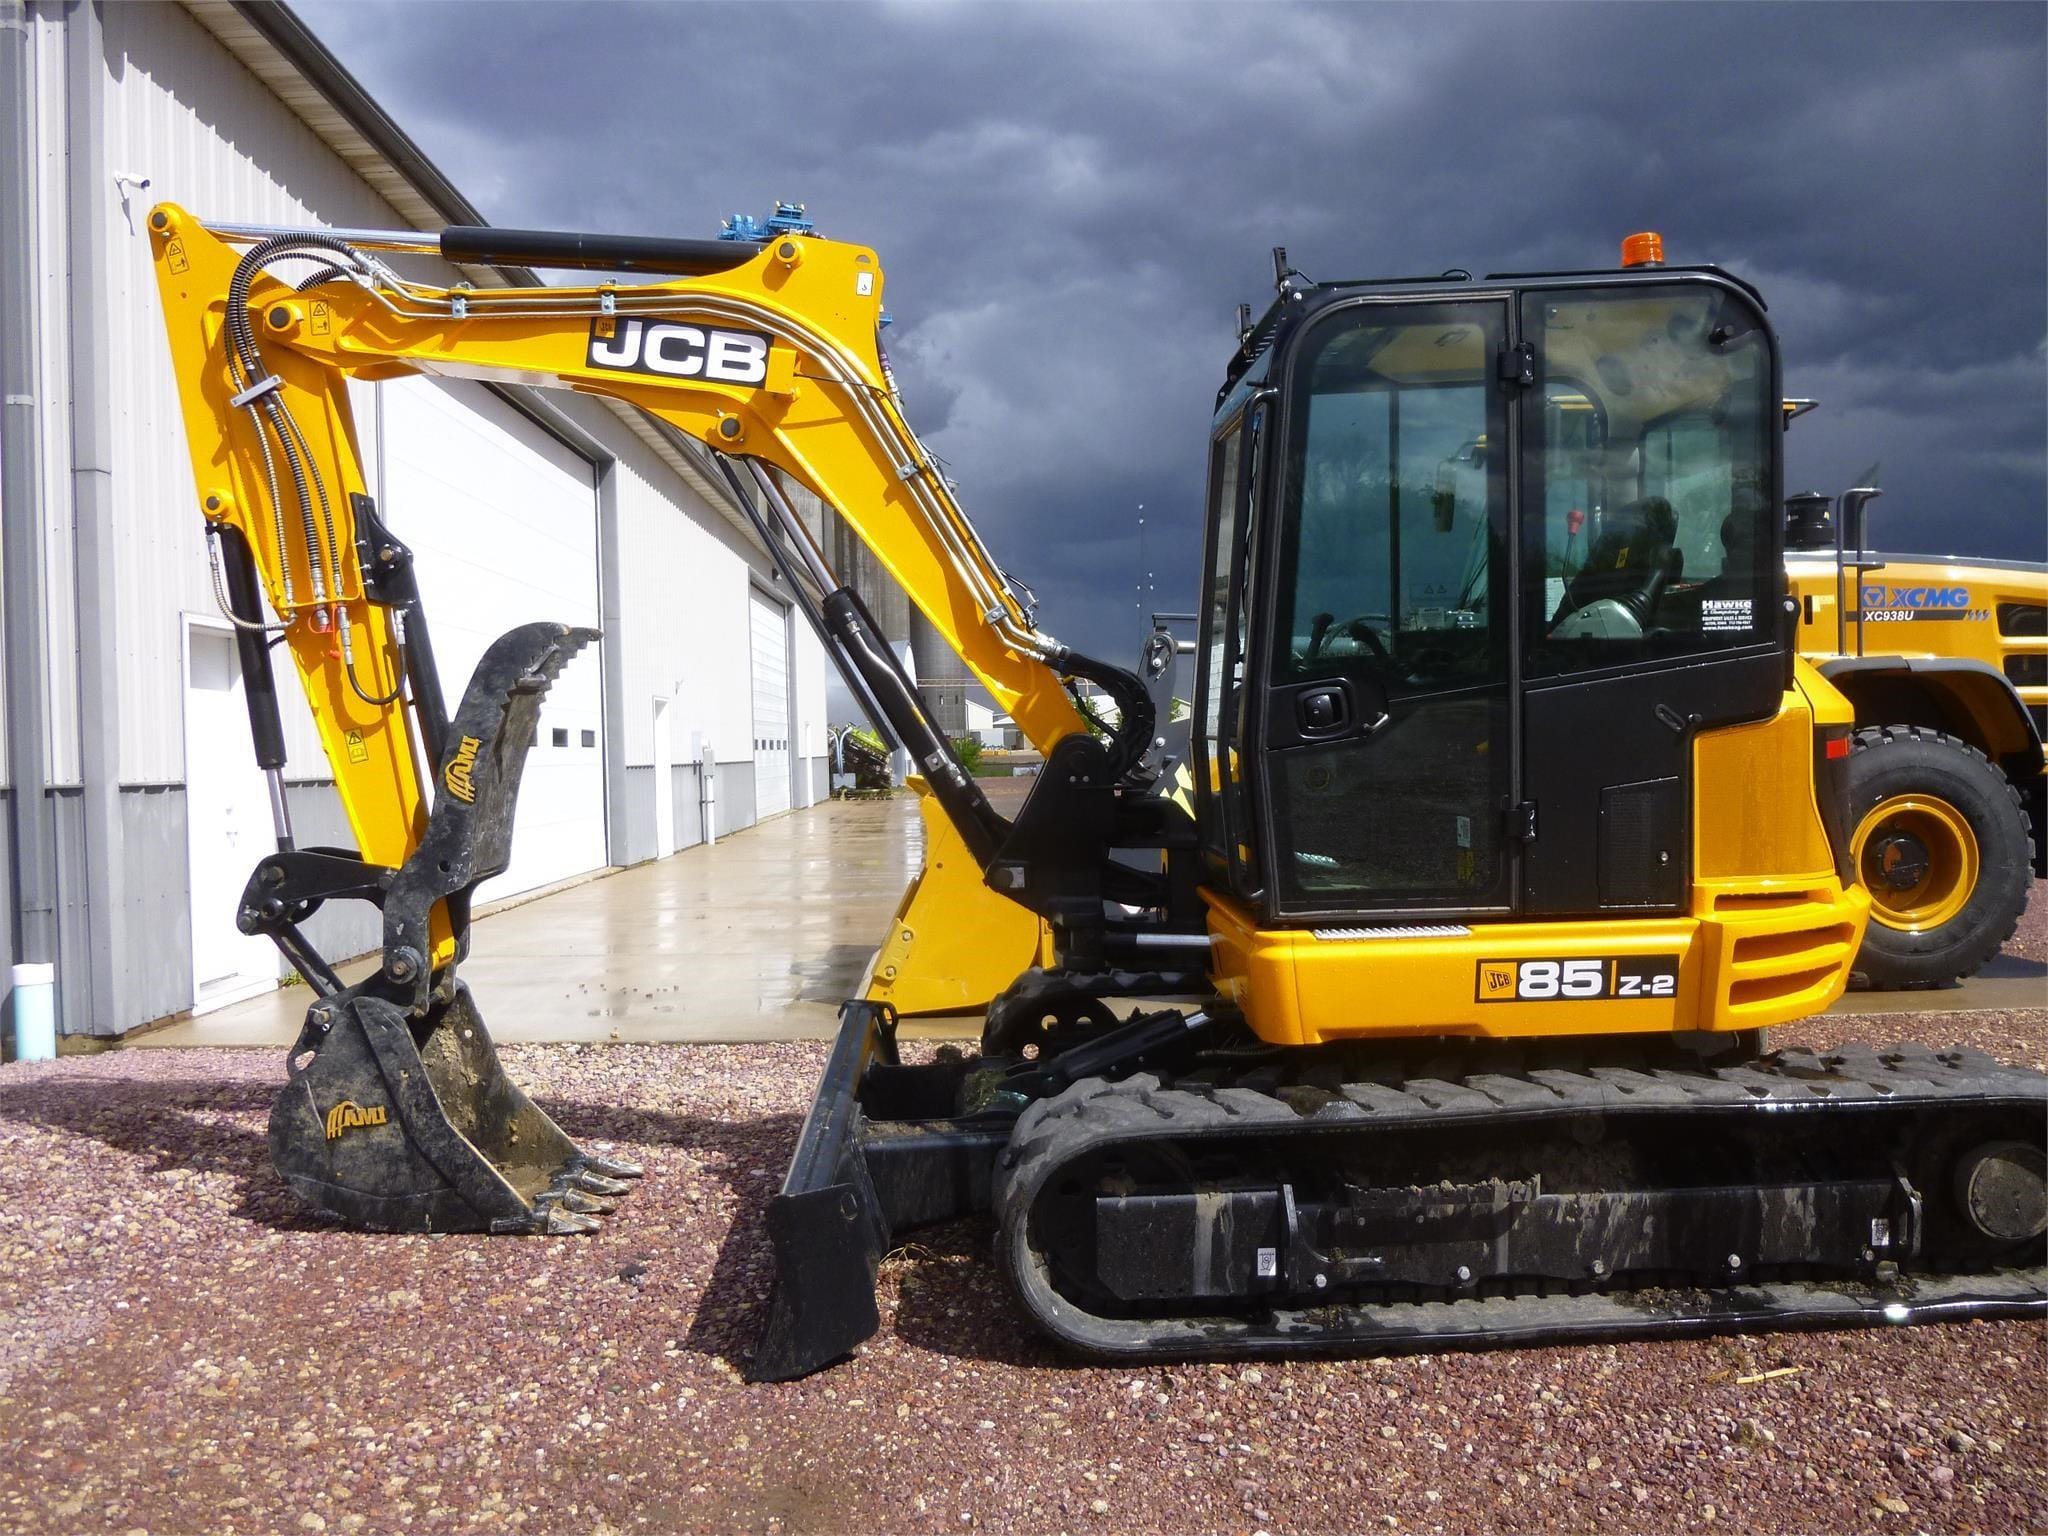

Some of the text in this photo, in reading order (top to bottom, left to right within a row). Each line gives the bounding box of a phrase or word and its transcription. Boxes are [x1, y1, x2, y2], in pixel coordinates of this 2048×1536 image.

[592, 320, 768, 383] JCB
[1888, 587, 1969, 608] XCMG
[1864, 610, 1914, 621] XC938U
[1489, 959, 1674, 998] JCB 85 Z-2
